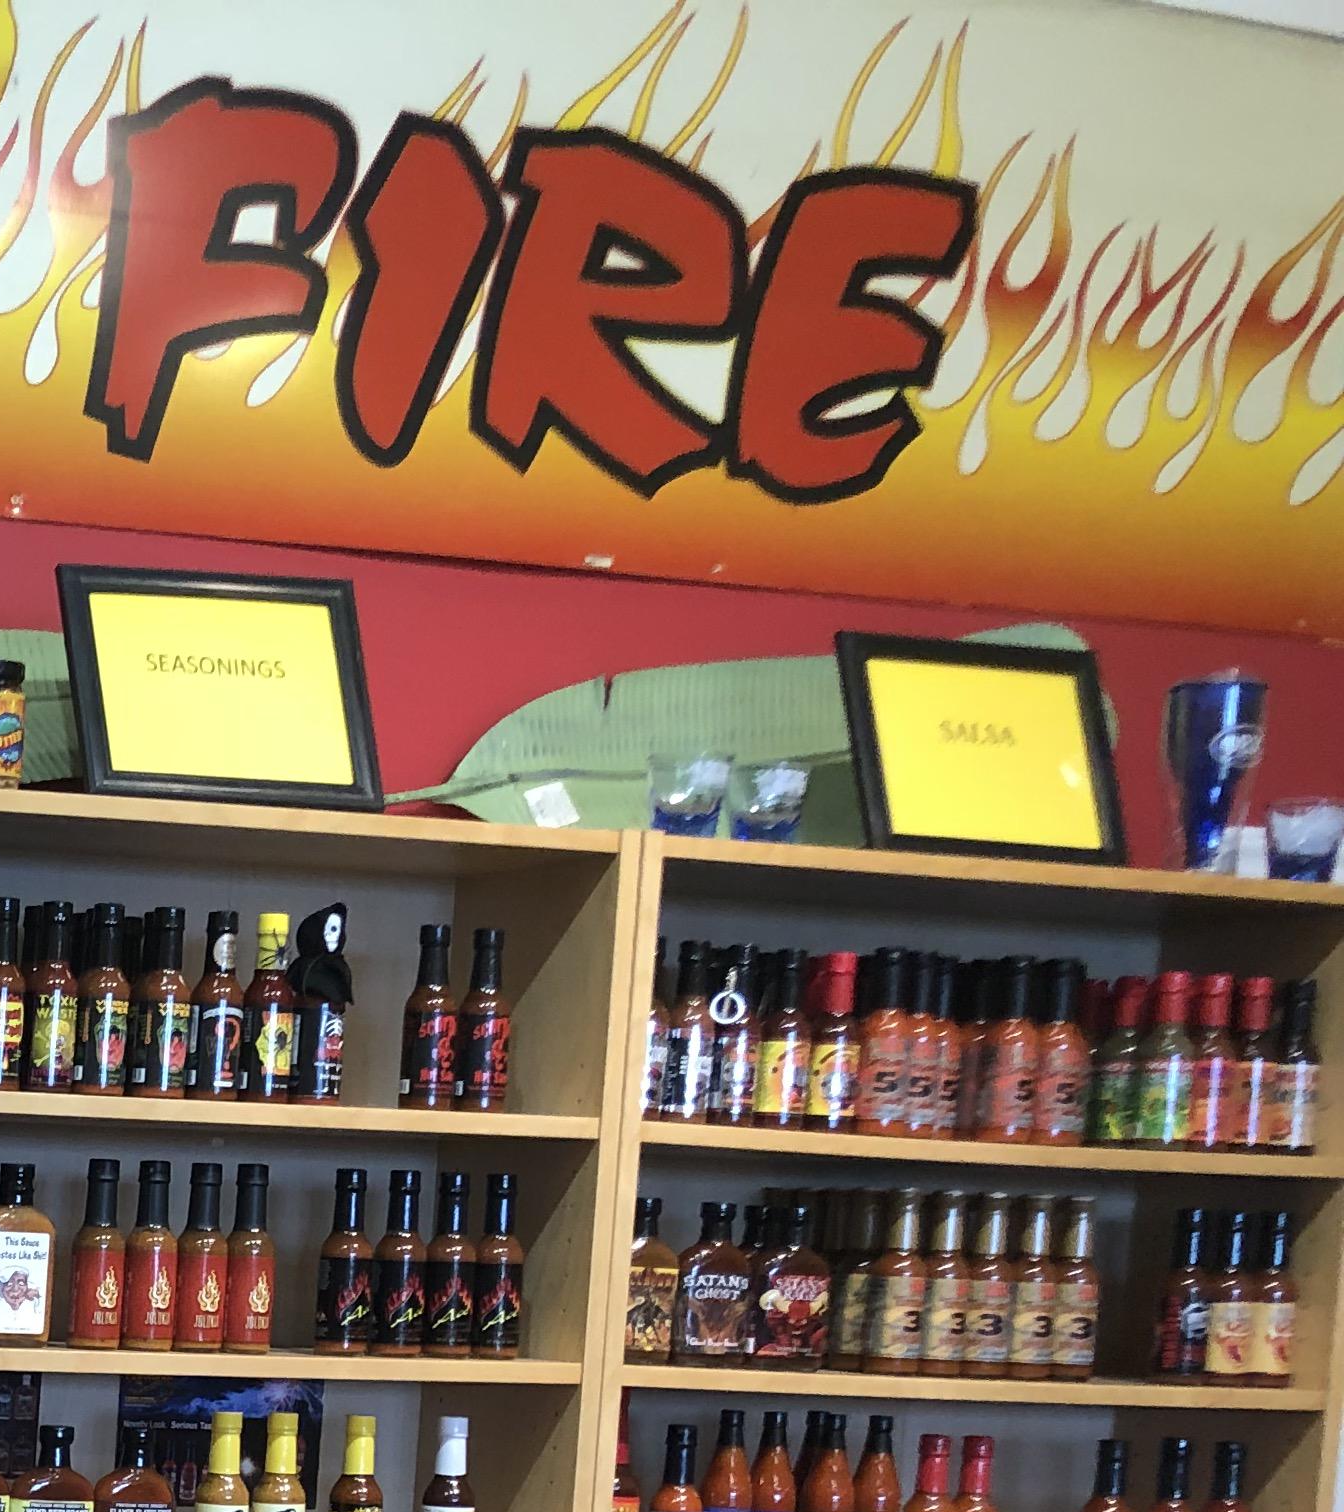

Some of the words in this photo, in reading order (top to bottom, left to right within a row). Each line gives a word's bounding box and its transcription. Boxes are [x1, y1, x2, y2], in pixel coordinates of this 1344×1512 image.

[84, 76, 977, 504] FIRE
[146, 652, 287, 685] SEASONINGS
[5, 1236, 18, 1247] This
